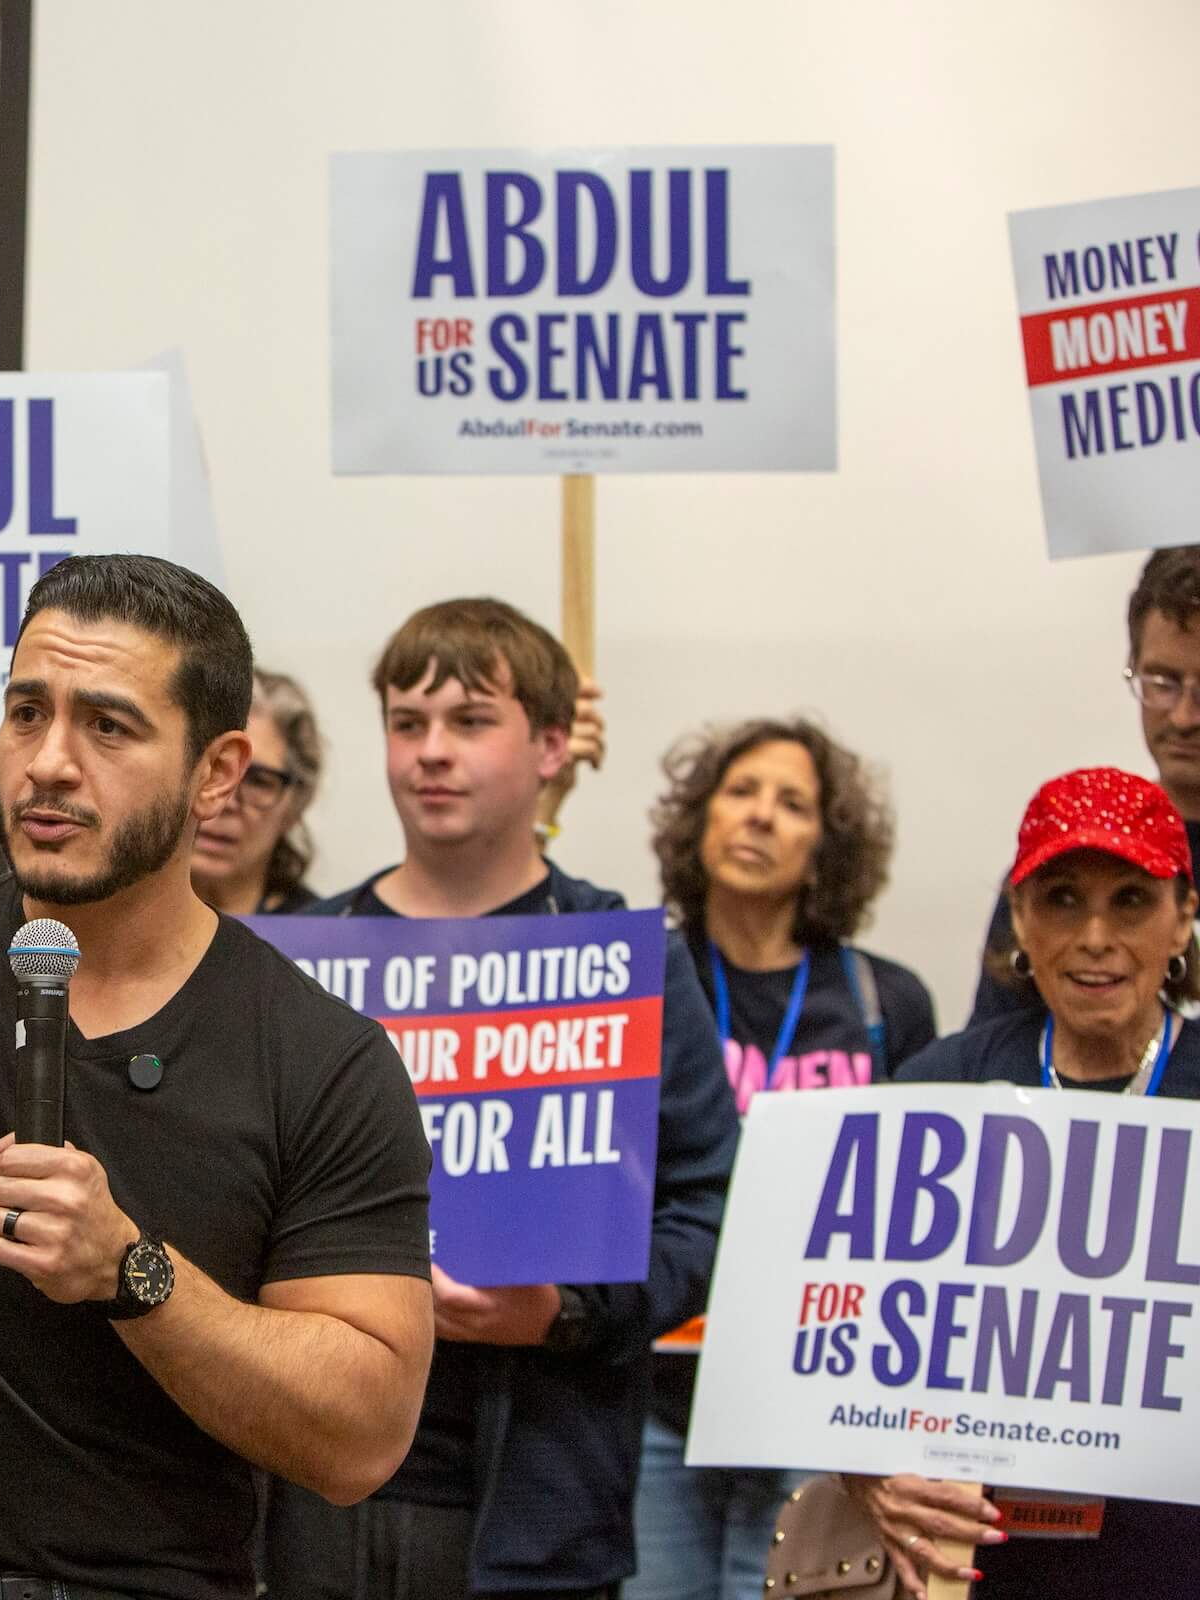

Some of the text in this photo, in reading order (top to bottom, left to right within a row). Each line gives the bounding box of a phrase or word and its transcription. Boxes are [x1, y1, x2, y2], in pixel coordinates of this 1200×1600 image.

[411, 168, 750, 299] ABDUL
[1044, 233, 1178, 300] MONEY
[415, 318, 473, 354] FOR
[487, 312, 748, 401] SENATE
[1049, 300, 1188, 372] MONEY
[417, 353, 473, 397] US
[458, 418, 704, 439] AbdulForSenate.com
[40, 988, 65, 997] SHURE
[384, 955, 436, 1011] OF
[449, 941, 631, 1010] POLITICS
[388, 1014, 629, 1084] UR POCKET
[420, 1090, 621, 1177] FOR ALL
[803, 1111, 1200, 1285] ABDUL
[800, 1282, 865, 1327] FOR
[791, 1322, 860, 1378] US
[871, 1278, 1193, 1413] SENATE
[829, 1404, 1121, 1450] AbdulForSenate.com
